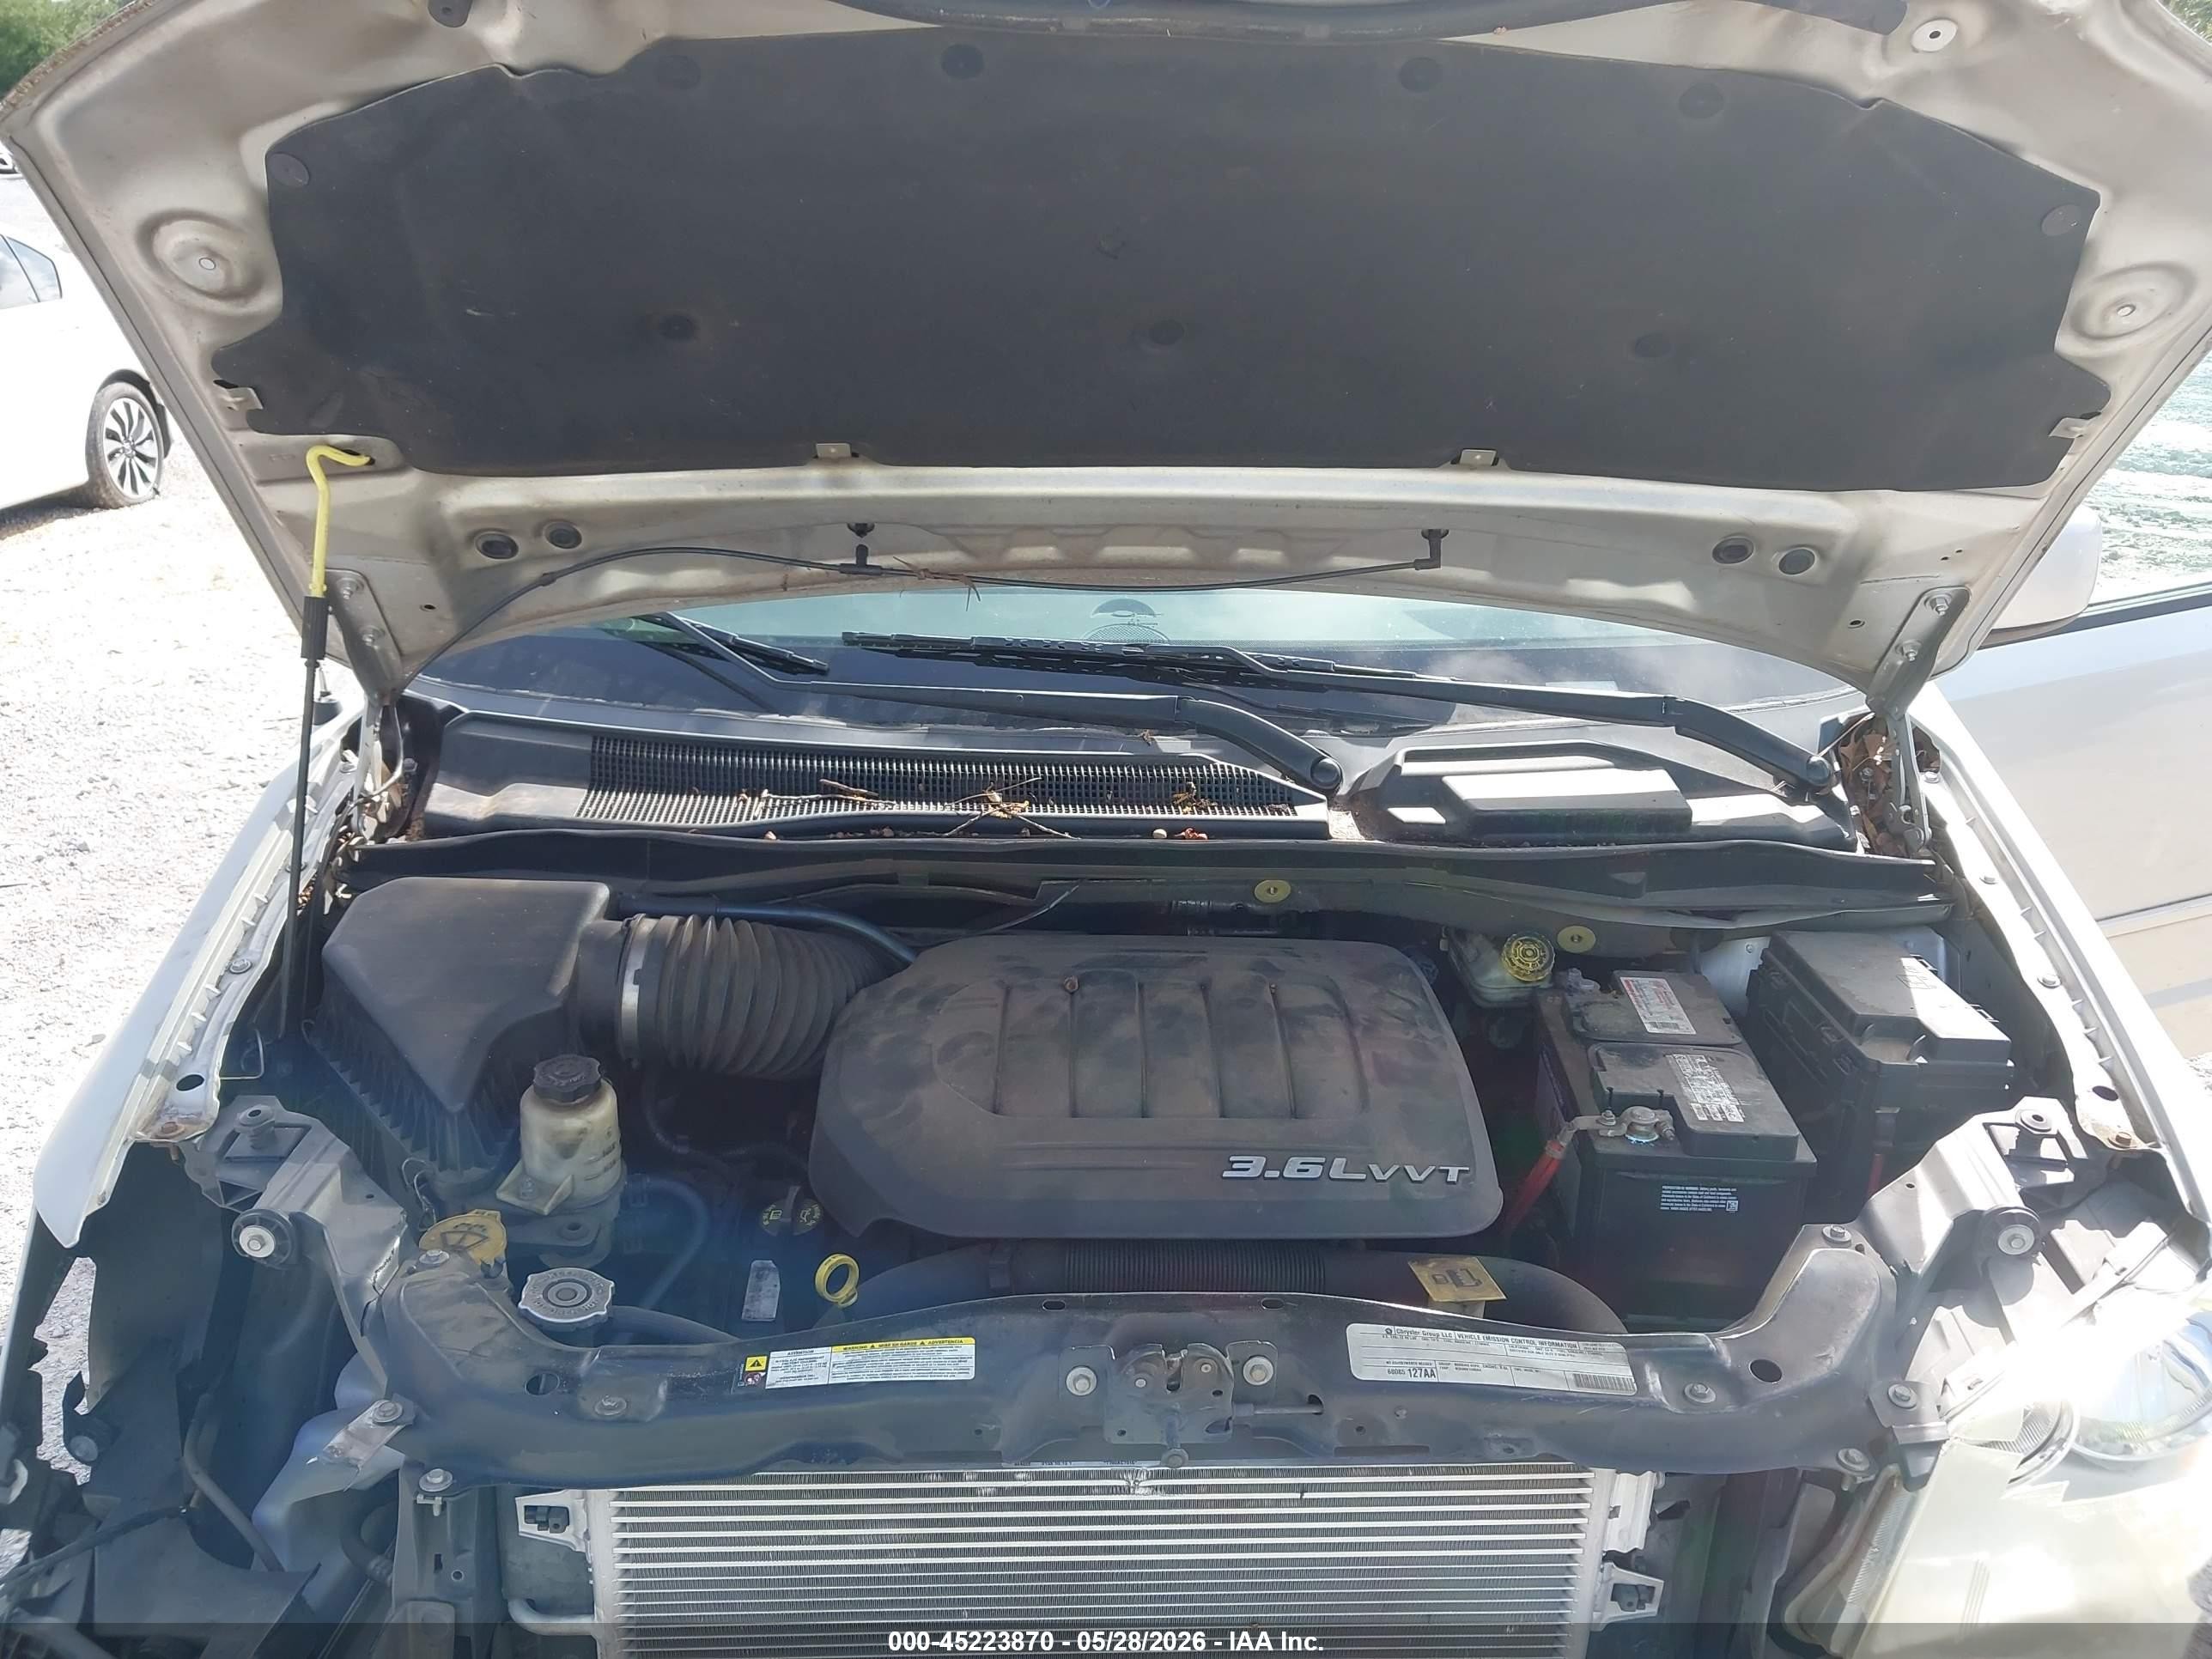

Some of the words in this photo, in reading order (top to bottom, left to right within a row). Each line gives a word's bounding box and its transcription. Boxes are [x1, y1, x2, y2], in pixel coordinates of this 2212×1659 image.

[1395, 1328, 1420, 1336] Chrysler
[1421, 1329, 1440, 1338] Group
[1538, 1340, 1577, 1349] INFORMATION
[1407, 1367, 1437, 1378] 127AA
